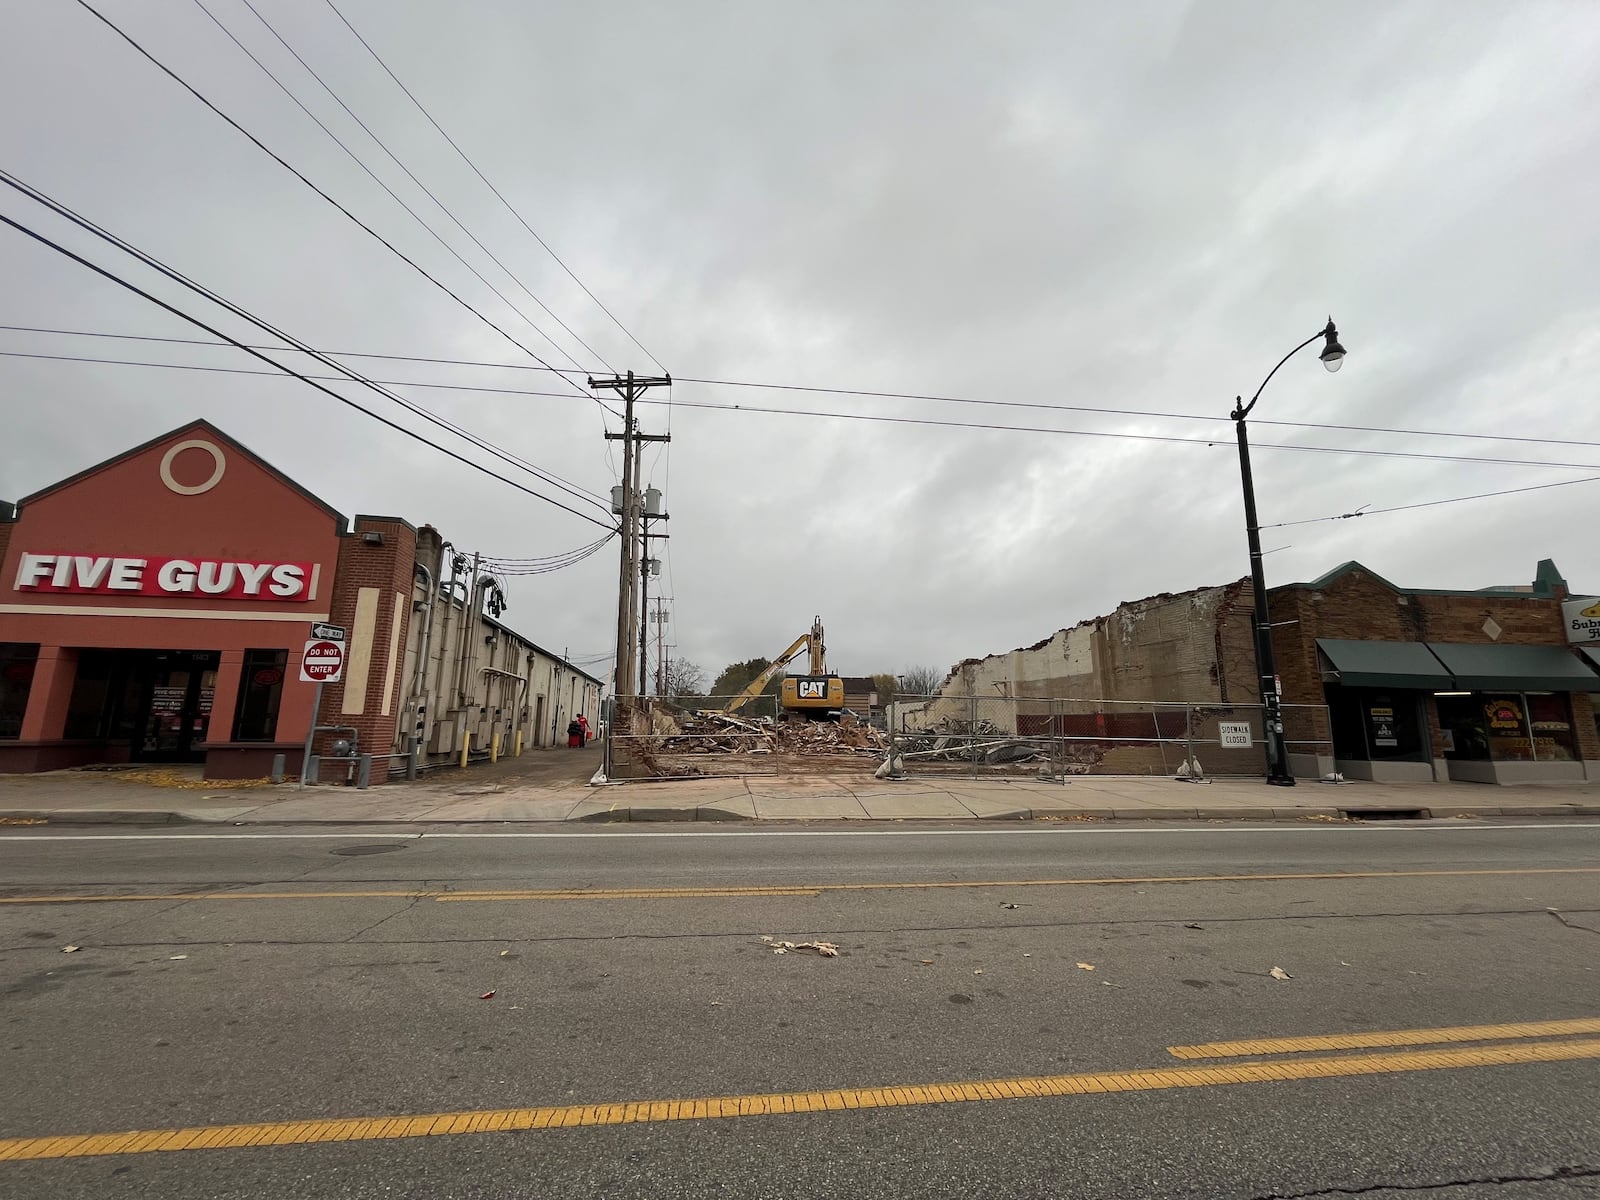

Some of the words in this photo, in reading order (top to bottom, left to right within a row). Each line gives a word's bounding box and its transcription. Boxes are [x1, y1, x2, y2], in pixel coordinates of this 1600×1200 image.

[20, 554, 148, 590] FIVE
[157, 559, 305, 597] GUYS
[799, 681, 825, 697] CAT
